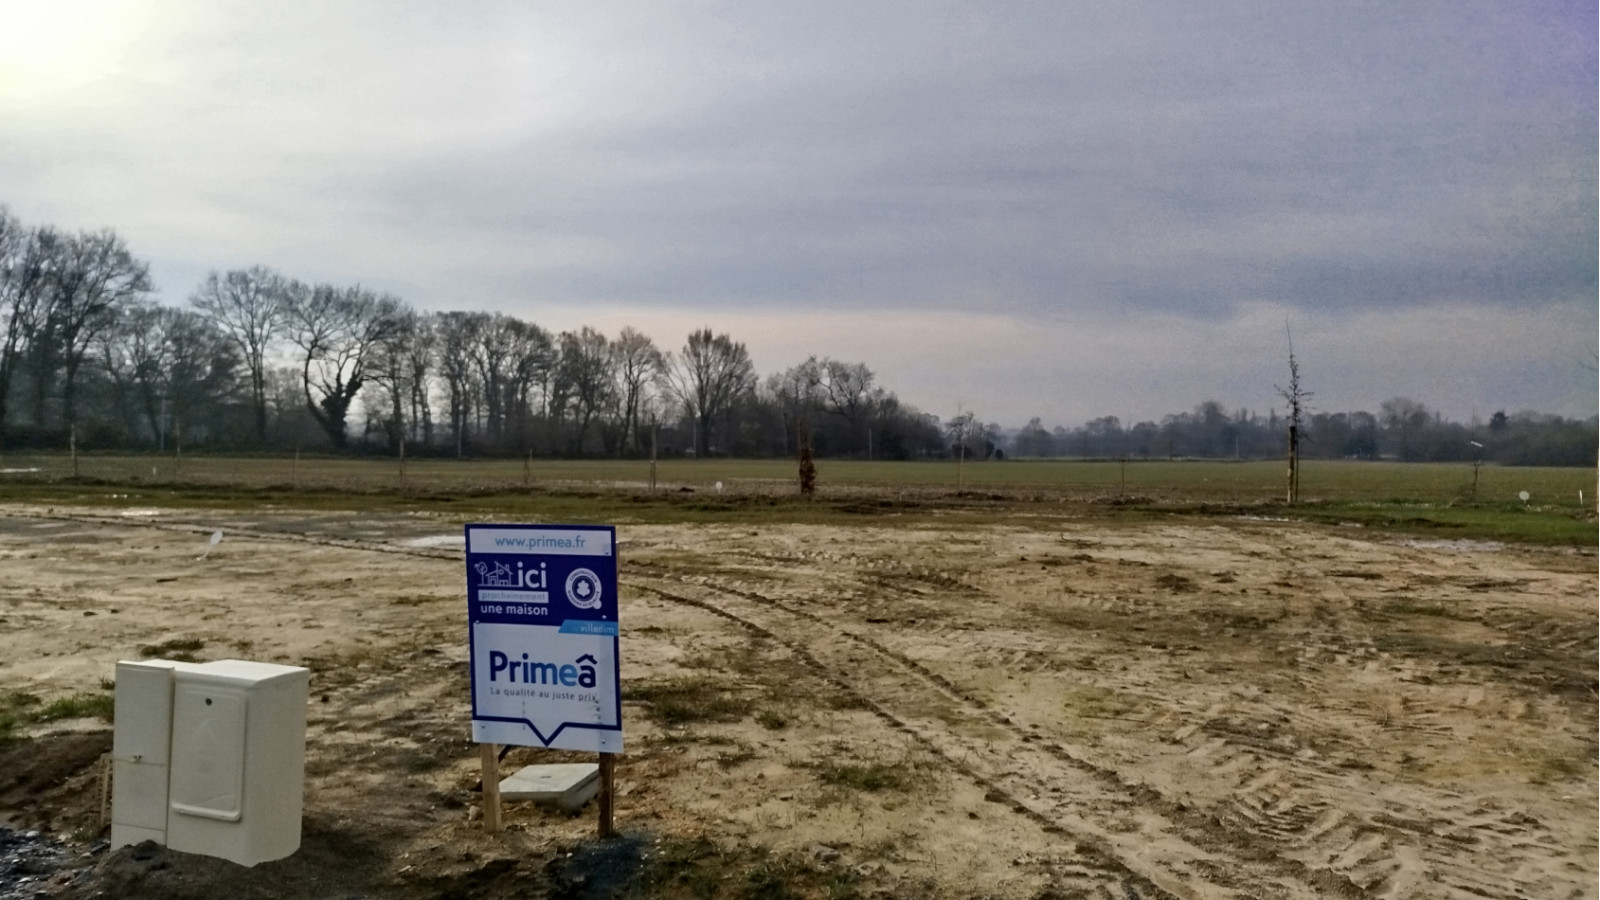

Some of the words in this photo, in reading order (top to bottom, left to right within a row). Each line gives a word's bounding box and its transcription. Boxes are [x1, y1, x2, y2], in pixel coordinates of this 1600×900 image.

[495, 535, 586, 549] www.primea.fr
[517, 561, 547, 588] ici
[481, 591, 546, 600] prochainement
[480, 604, 503, 614] une
[506, 603, 548, 616] maison
[490, 687, 500, 695] La
[503, 688, 535, 697] qualité
[552, 691, 575, 700] juste
[578, 693, 597, 702] prix
